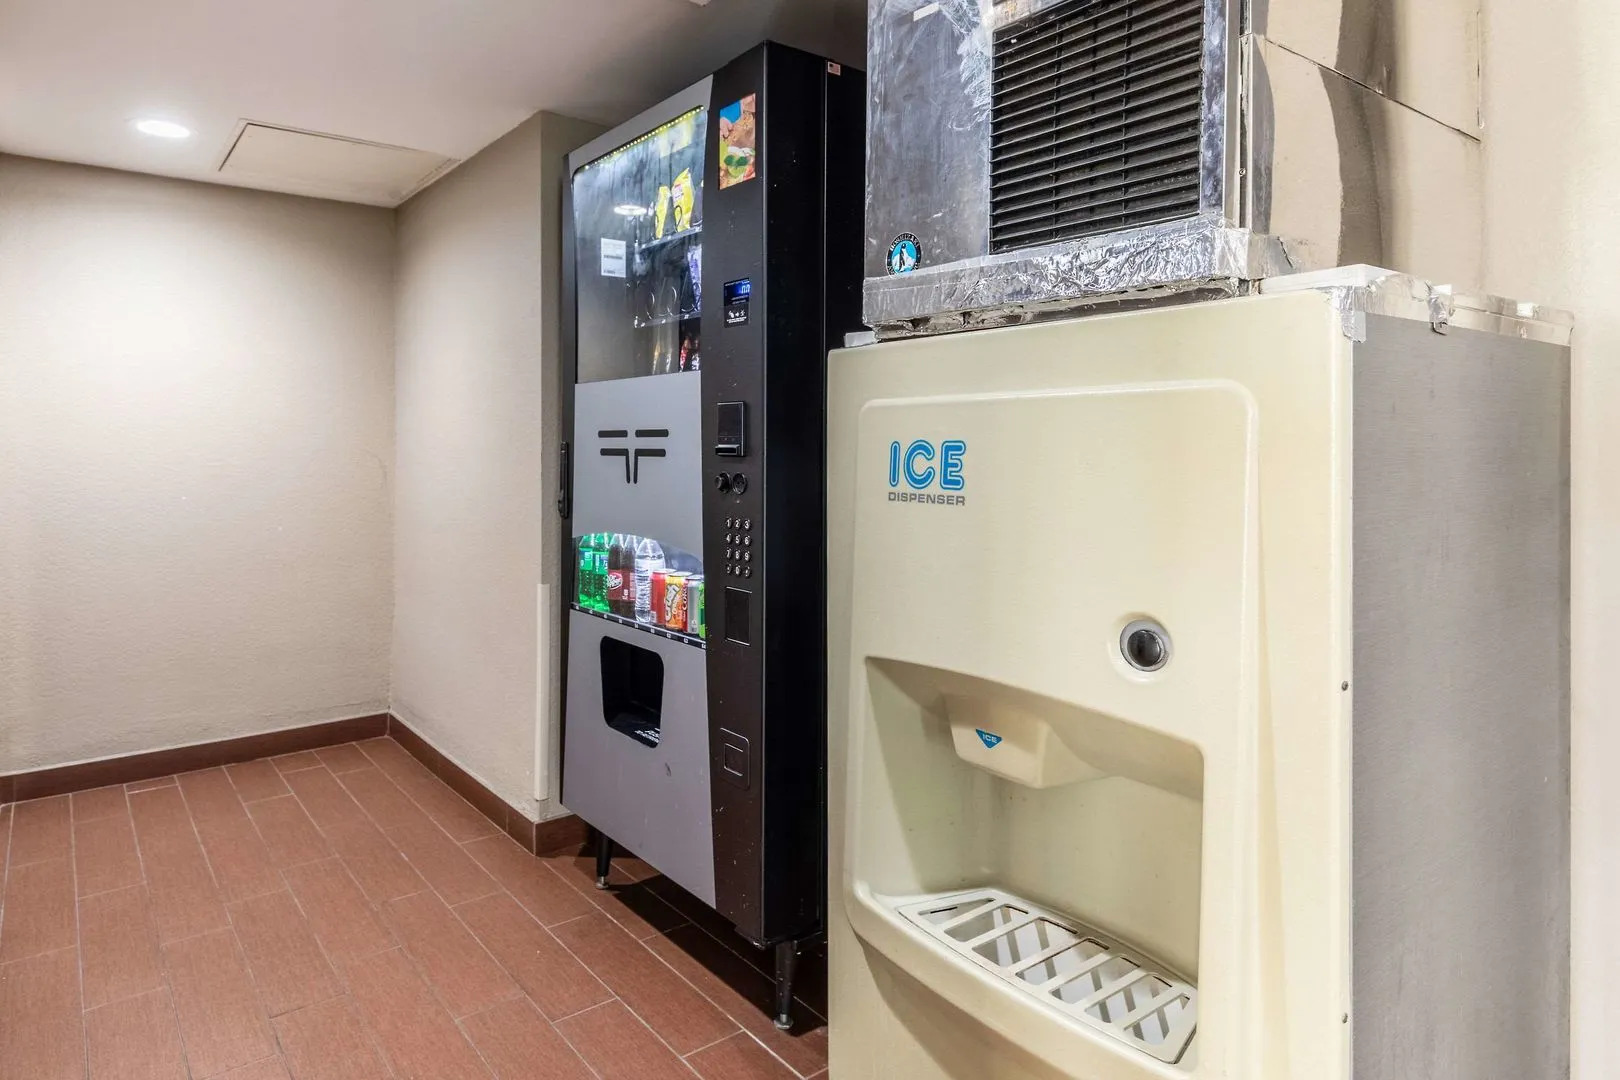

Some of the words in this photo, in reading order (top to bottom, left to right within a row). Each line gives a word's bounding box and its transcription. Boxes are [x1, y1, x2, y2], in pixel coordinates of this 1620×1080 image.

[889, 439, 966, 490] ICE
[888, 492, 966, 506] DISPENSER
[982, 733, 998, 744] ICE
